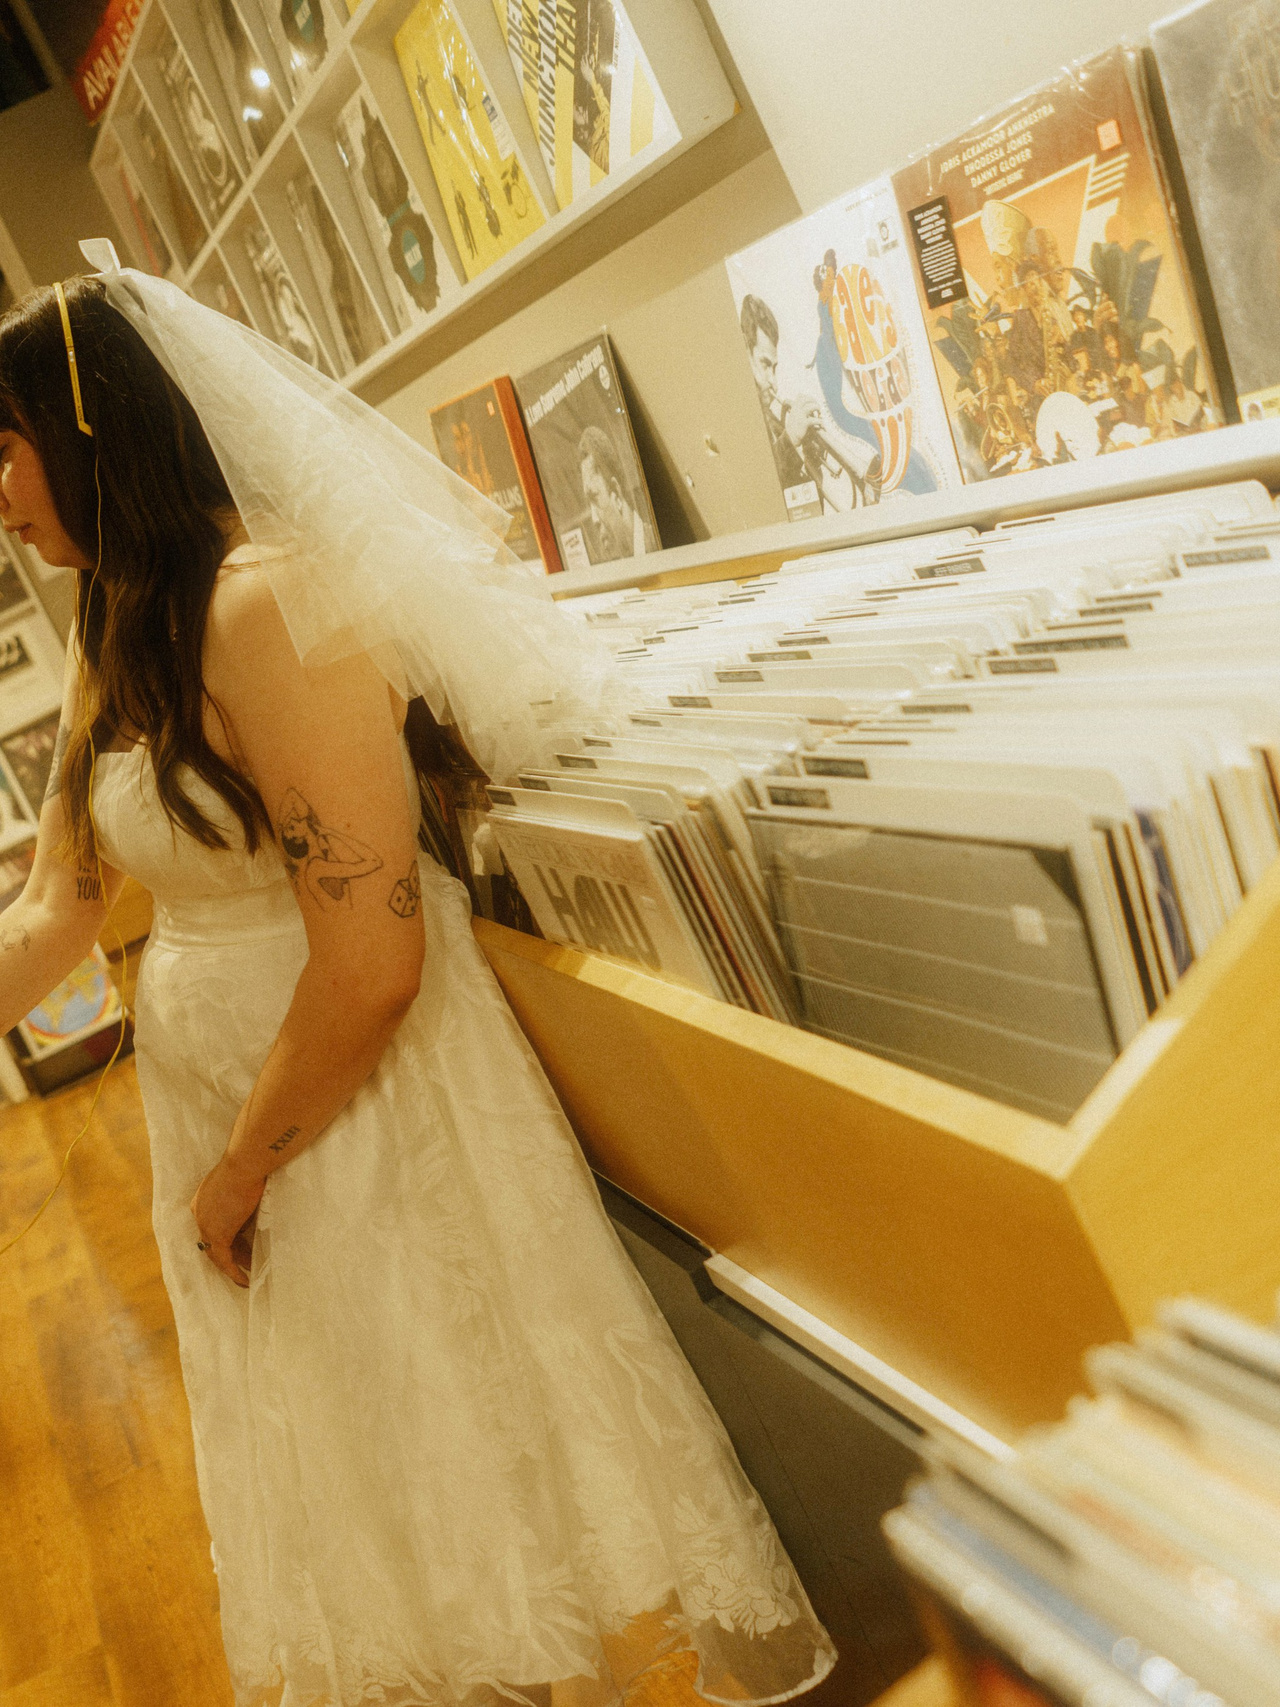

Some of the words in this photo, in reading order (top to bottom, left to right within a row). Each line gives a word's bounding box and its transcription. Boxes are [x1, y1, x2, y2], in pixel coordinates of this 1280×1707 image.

[940, 155, 961, 174] IDRIS
[962, 127, 1007, 162] ACKAMOOR
[1005, 131, 1034, 156] JONES
[970, 167, 1000, 188] DANNY
[998, 149, 1033, 174] GLOVER
[576, 344, 604, 381] Coltrane
